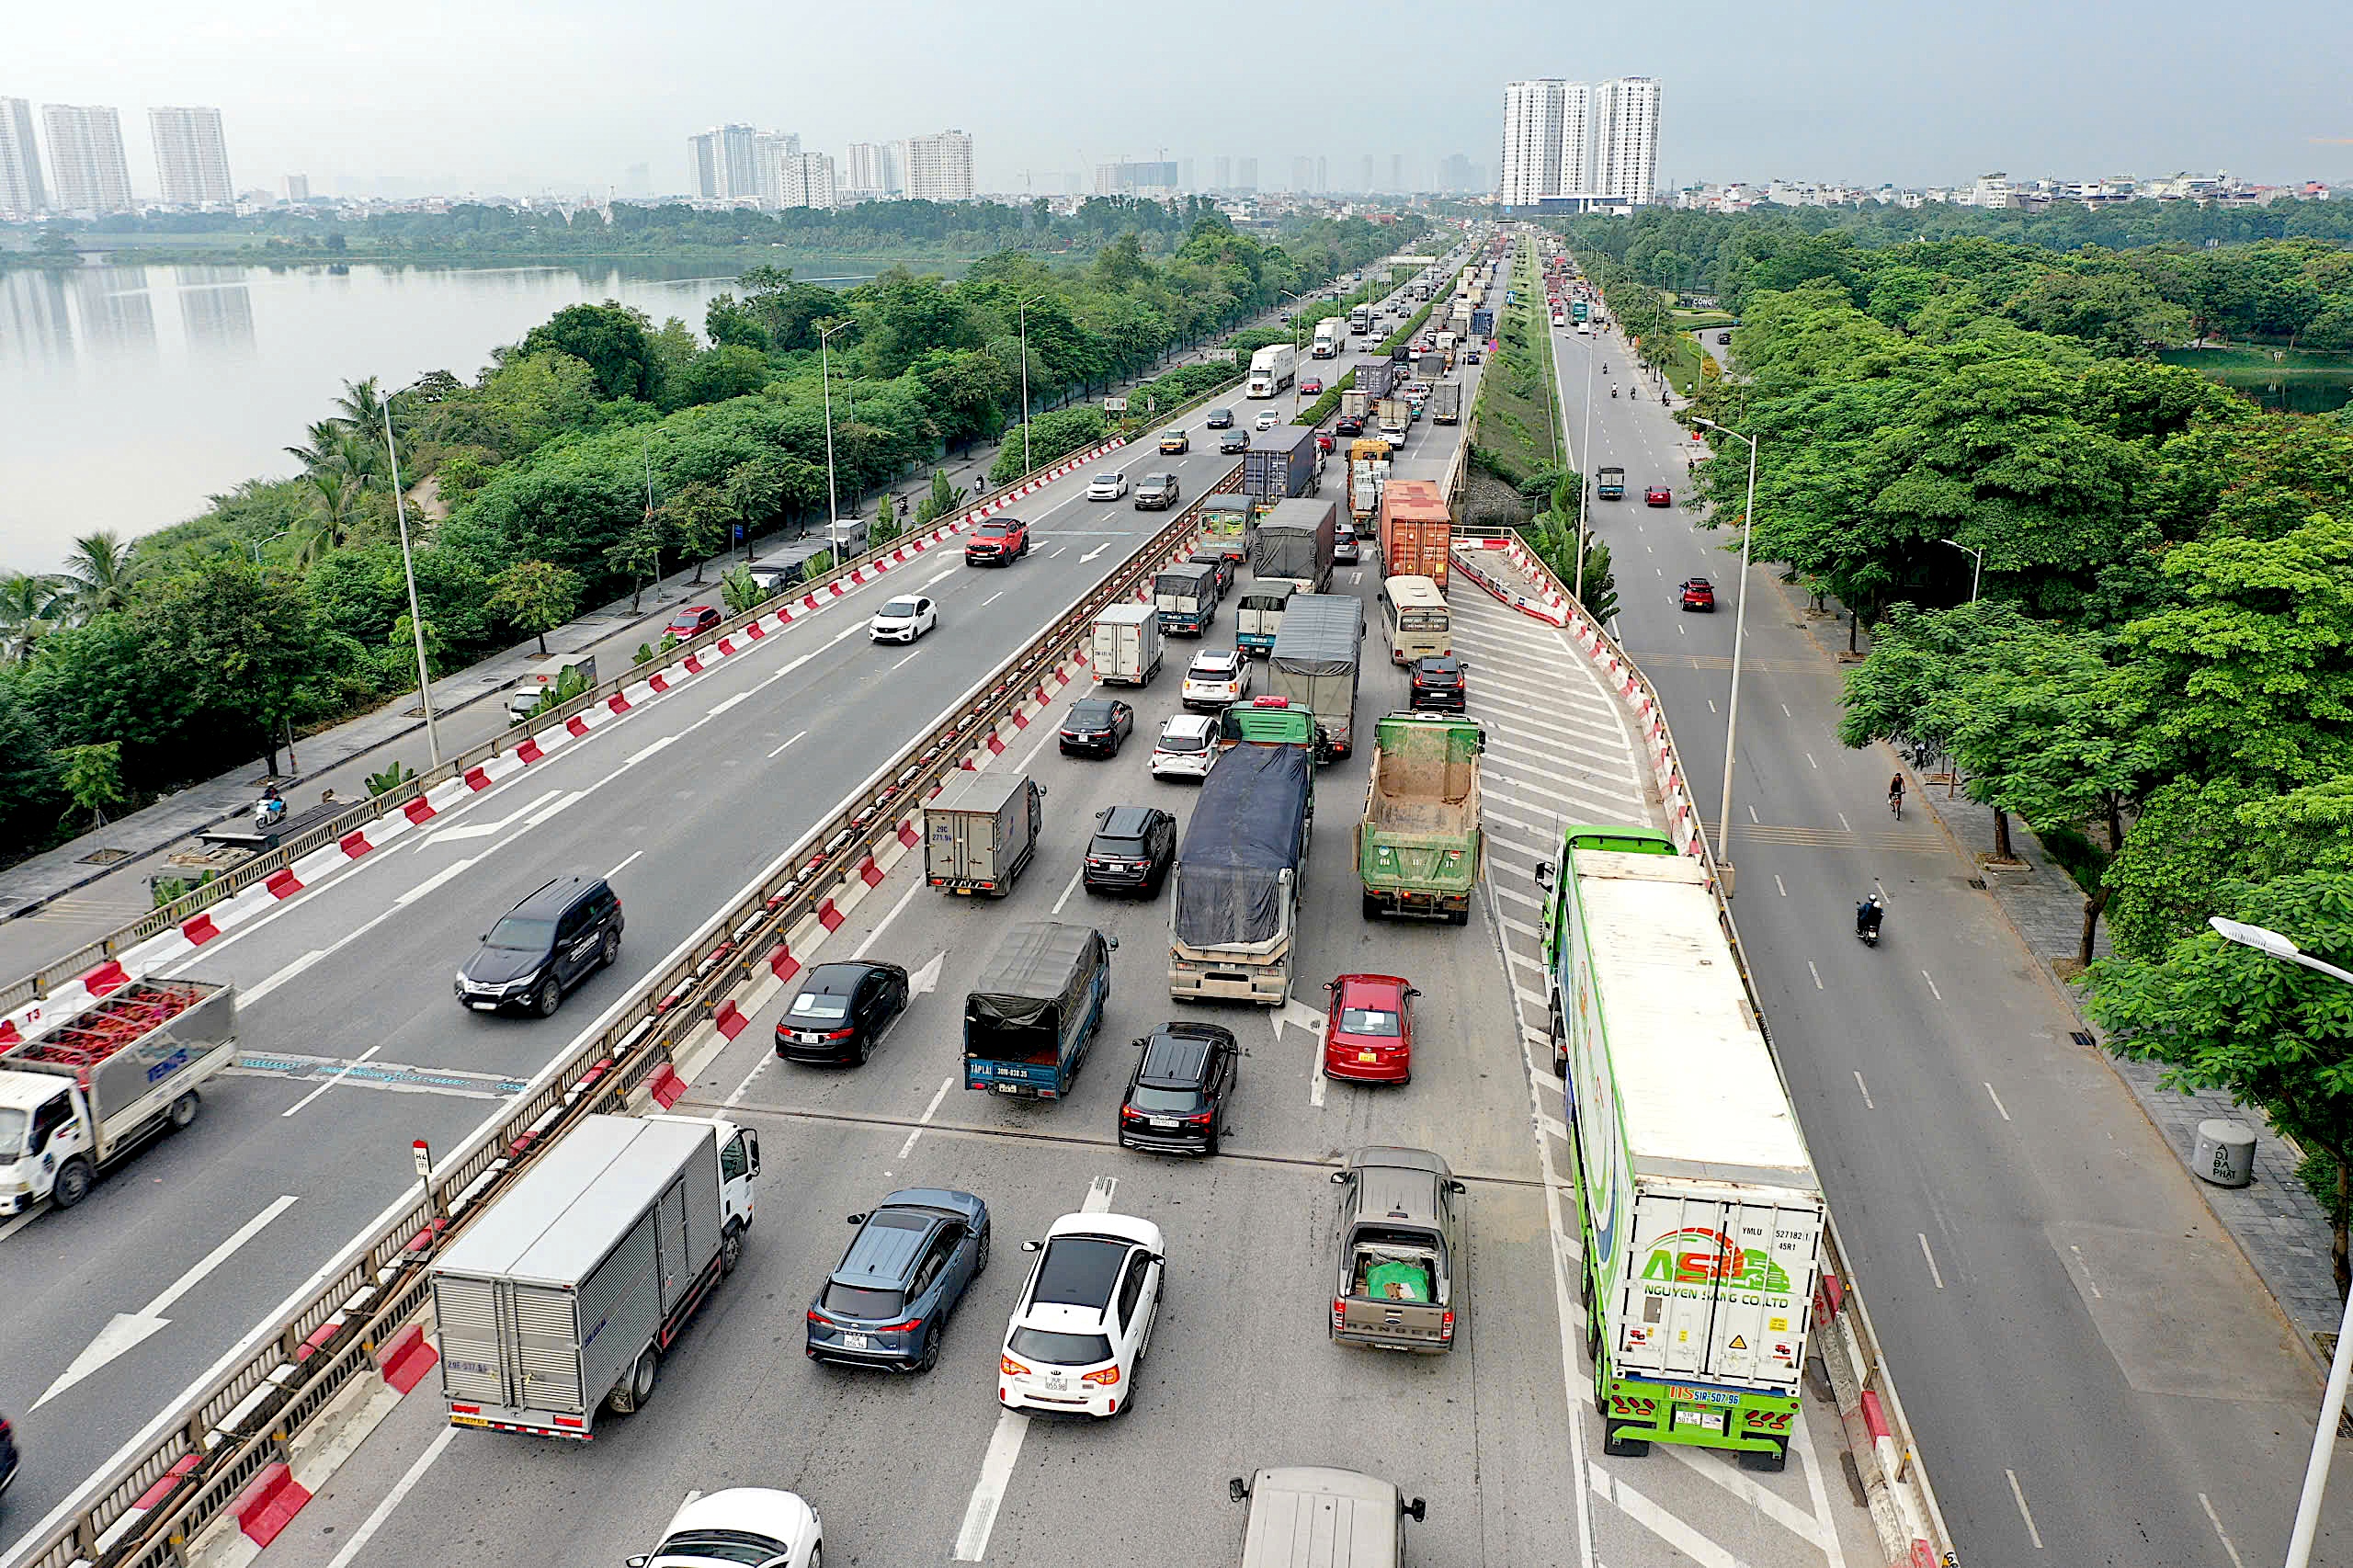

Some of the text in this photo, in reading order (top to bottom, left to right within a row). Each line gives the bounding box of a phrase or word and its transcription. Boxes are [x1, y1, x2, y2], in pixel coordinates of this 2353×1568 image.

[26, 1008, 40, 1023] T3
[1742, 1227, 1763, 1236] YMLU
[1775, 1230, 1802, 1240] 527182
[1779, 1243, 1796, 1251] 45R1
[1644, 1284, 1698, 1301] NGUYEN
